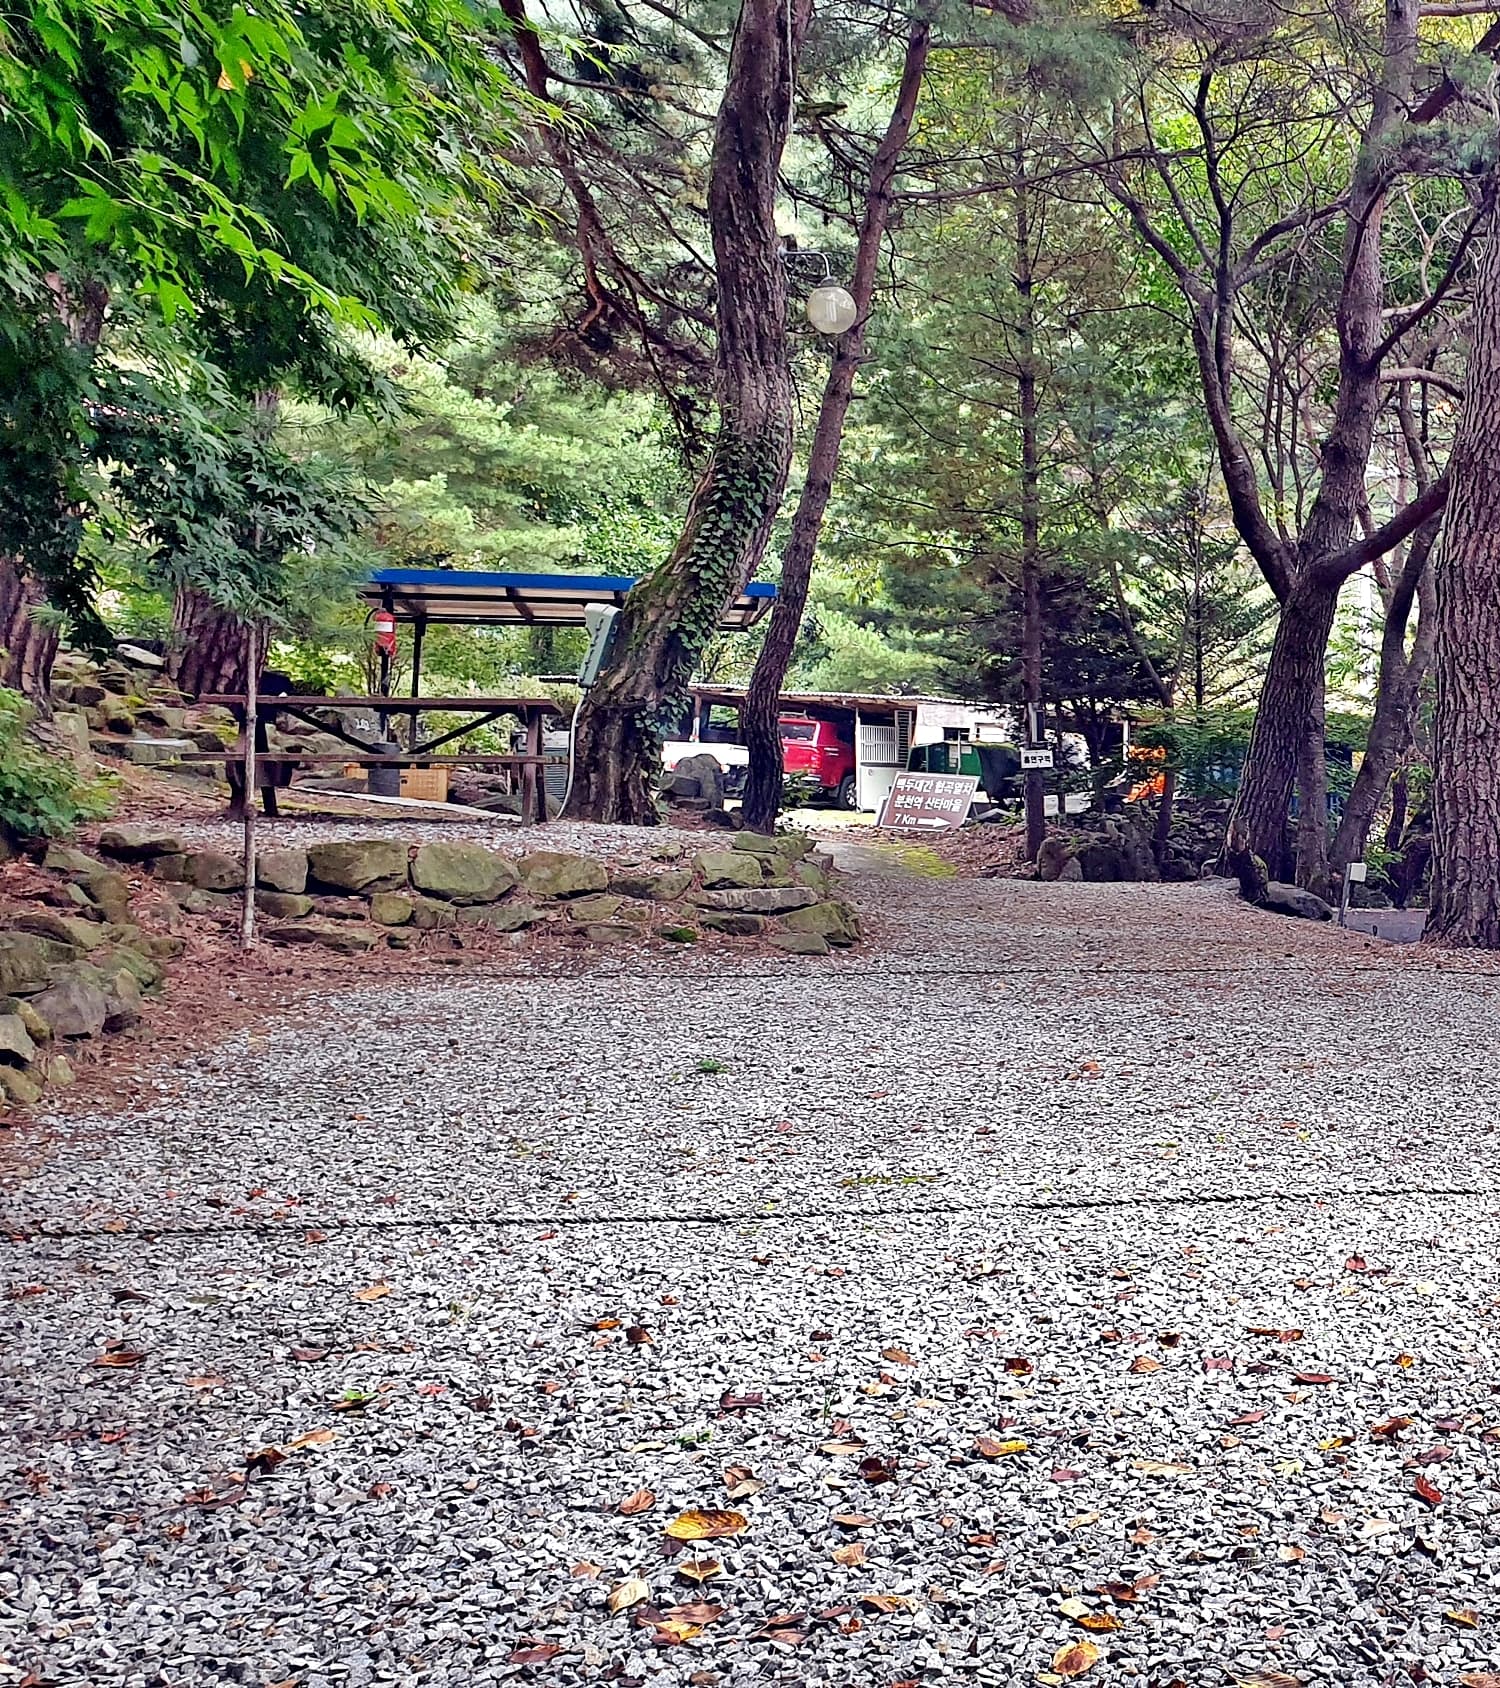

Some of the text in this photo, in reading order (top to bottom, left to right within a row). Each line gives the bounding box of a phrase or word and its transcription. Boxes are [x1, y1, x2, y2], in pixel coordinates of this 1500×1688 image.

[896, 778, 974, 796] 백두대간 협곡열차
[894, 795, 963, 812] 분천역 산타마을
[894, 813, 917, 825] 7 Km
